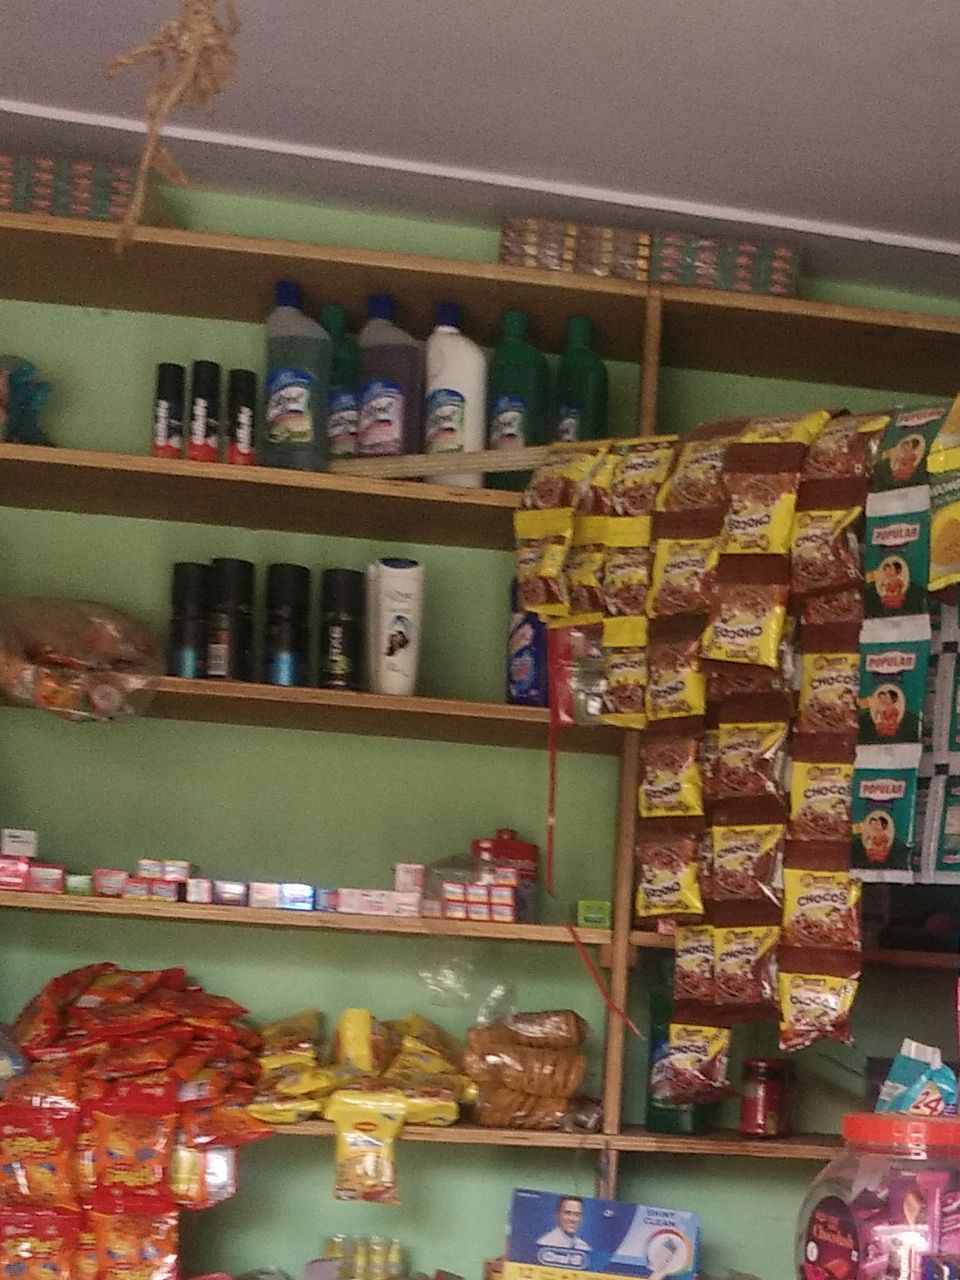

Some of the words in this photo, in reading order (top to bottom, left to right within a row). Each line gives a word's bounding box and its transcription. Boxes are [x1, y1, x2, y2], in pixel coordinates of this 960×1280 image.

[712, 625, 763, 642] CHOCOS
[867, 656, 914, 669] POPULAR
[862, 782, 904, 796] POPULAR
[796, 891, 847, 907] CHOCOS
[911, 1090, 943, 1117] 24
